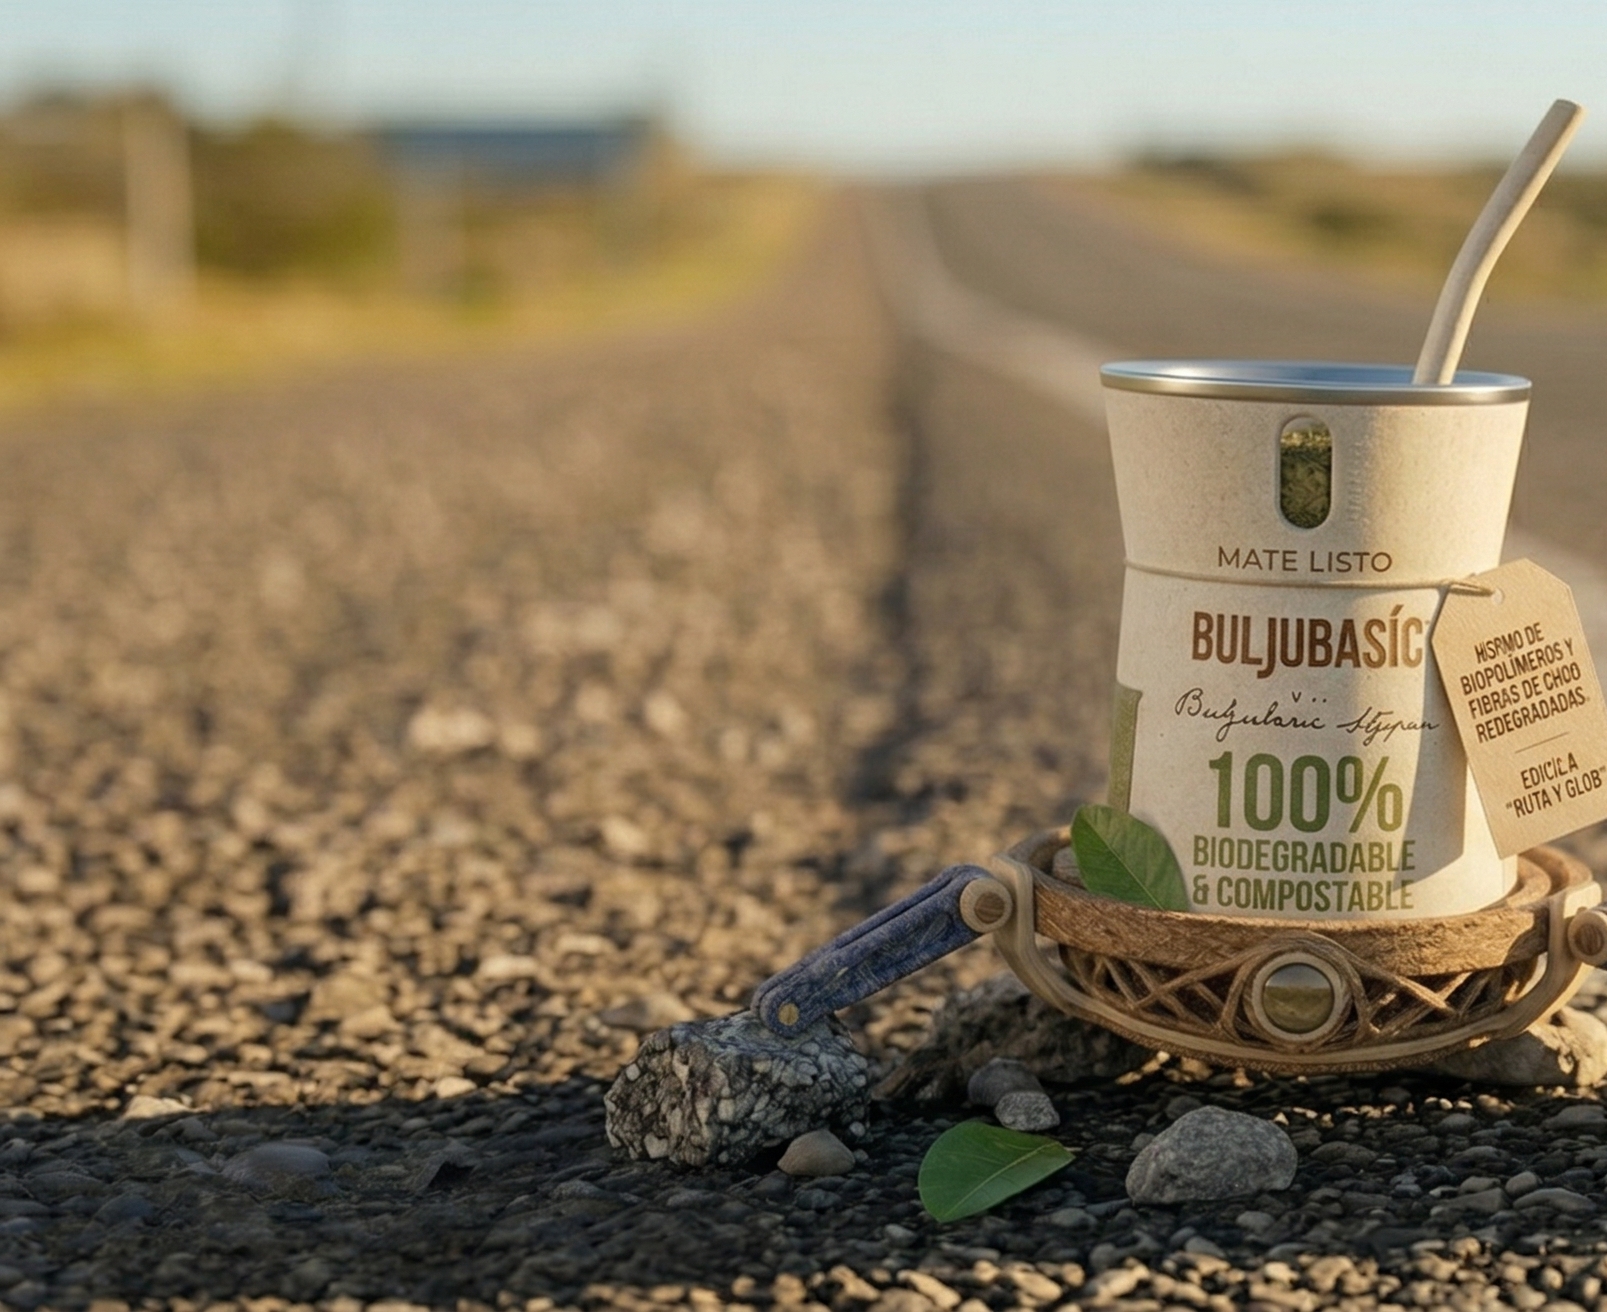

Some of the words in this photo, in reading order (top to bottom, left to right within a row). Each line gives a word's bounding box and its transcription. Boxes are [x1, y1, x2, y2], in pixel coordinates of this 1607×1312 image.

[1218, 546, 1298, 571] MATE
[1310, 551, 1392, 573] LISTO
[1524, 622, 1545, 646] DE
[1460, 641, 1564, 696] BIOPOLÍMEROS
[1563, 637, 1575, 657] Y
[1468, 683, 1521, 720] FIBRAS
[1521, 675, 1543, 700] DE
[1208, 751, 1403, 834] 100%
[1551, 783, 1563, 803] Y
[1193, 835, 1416, 874] BIODEGRADABLE
[1192, 874, 1210, 905] &
[1217, 876, 1415, 912] COMPOSTABLE
